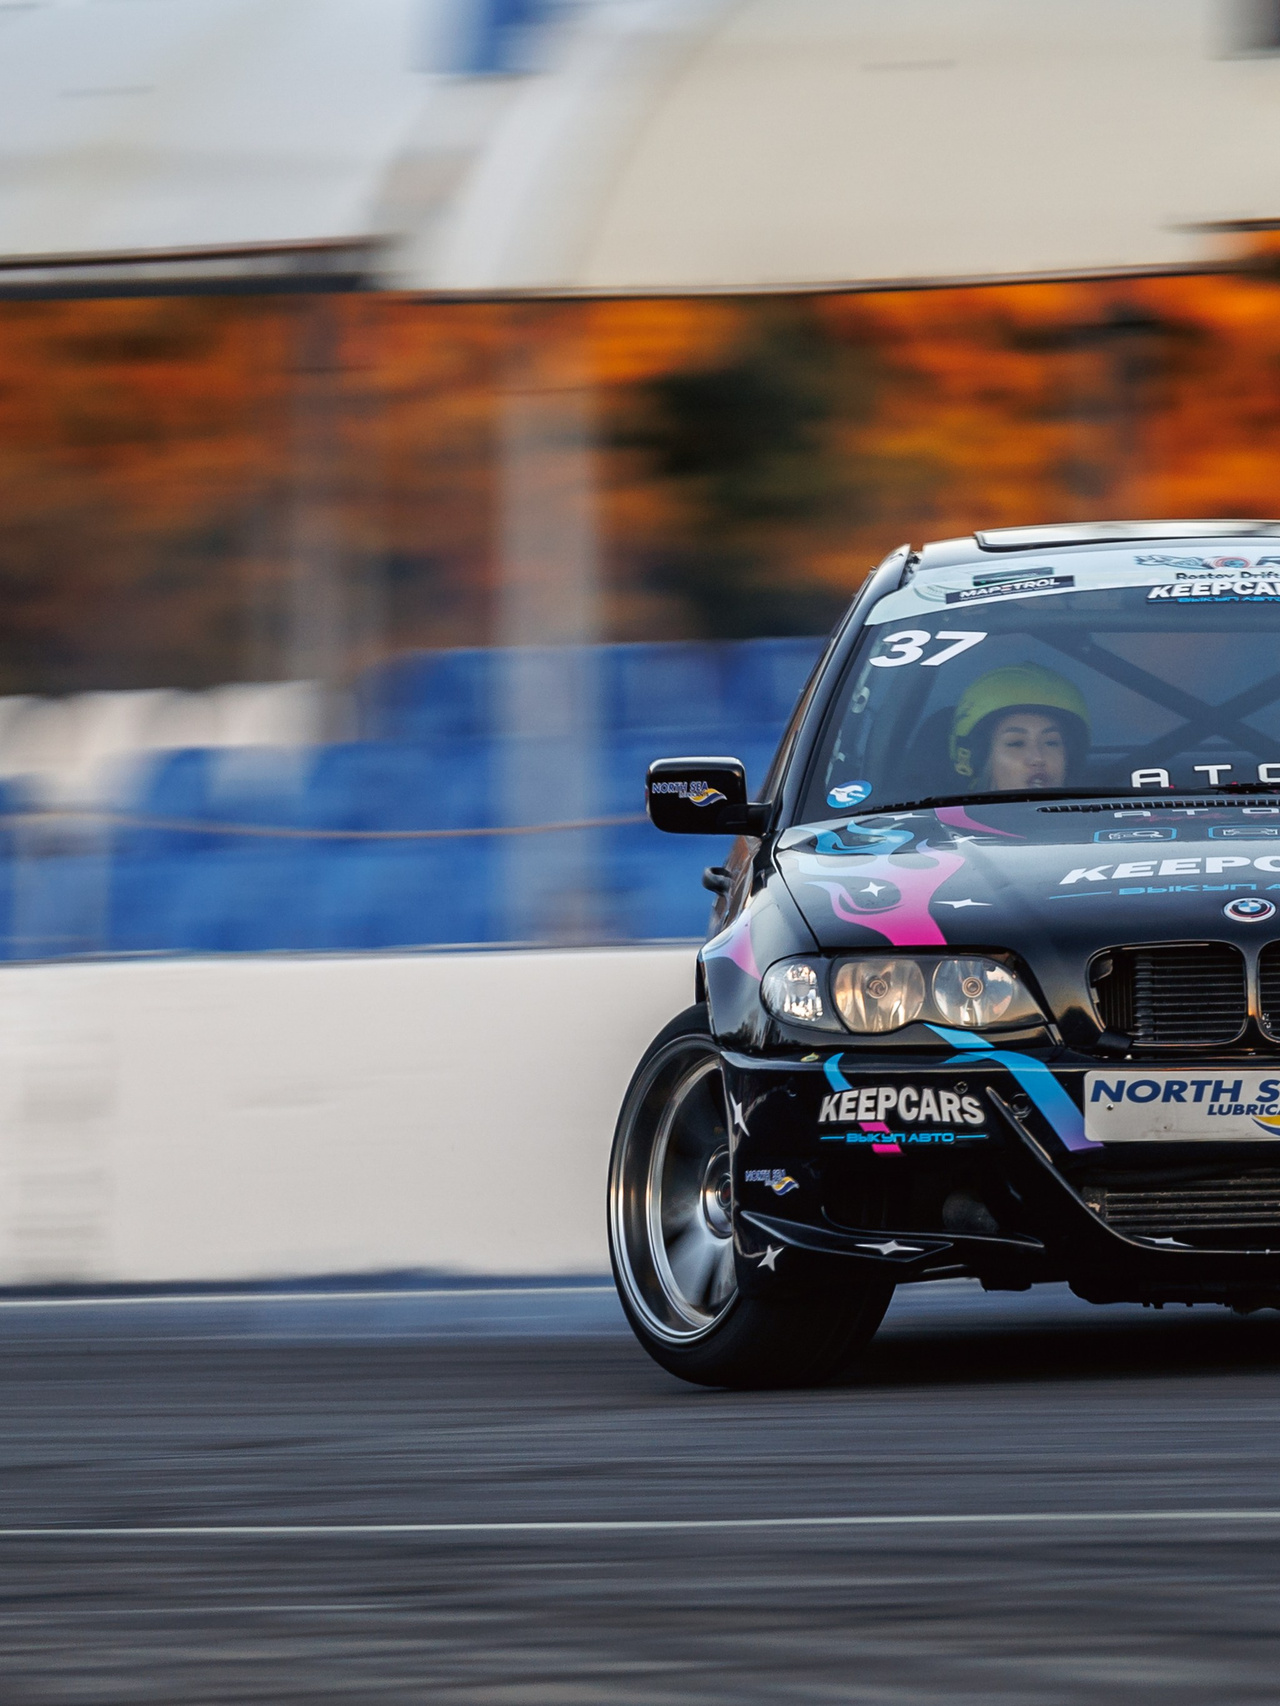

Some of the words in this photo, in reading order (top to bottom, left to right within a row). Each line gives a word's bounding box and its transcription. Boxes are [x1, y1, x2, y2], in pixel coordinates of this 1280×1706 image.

[1175, 572, 1235, 581] Rostov
[1239, 571, 1280, 580] Drift
[959, 578, 1061, 599] MAPETROL
[868, 629, 989, 668] 37
[651, 781, 688, 794] NORTH
[689, 780, 709, 793] SEA
[1118, 883, 1257, 896] ВЫКУП
[1090, 1079, 1244, 1104] NORTH
[817, 1086, 986, 1125] KEEPCARS
[846, 1132, 906, 1144] ВЫКУП
[907, 1132, 955, 1143] АВТО
